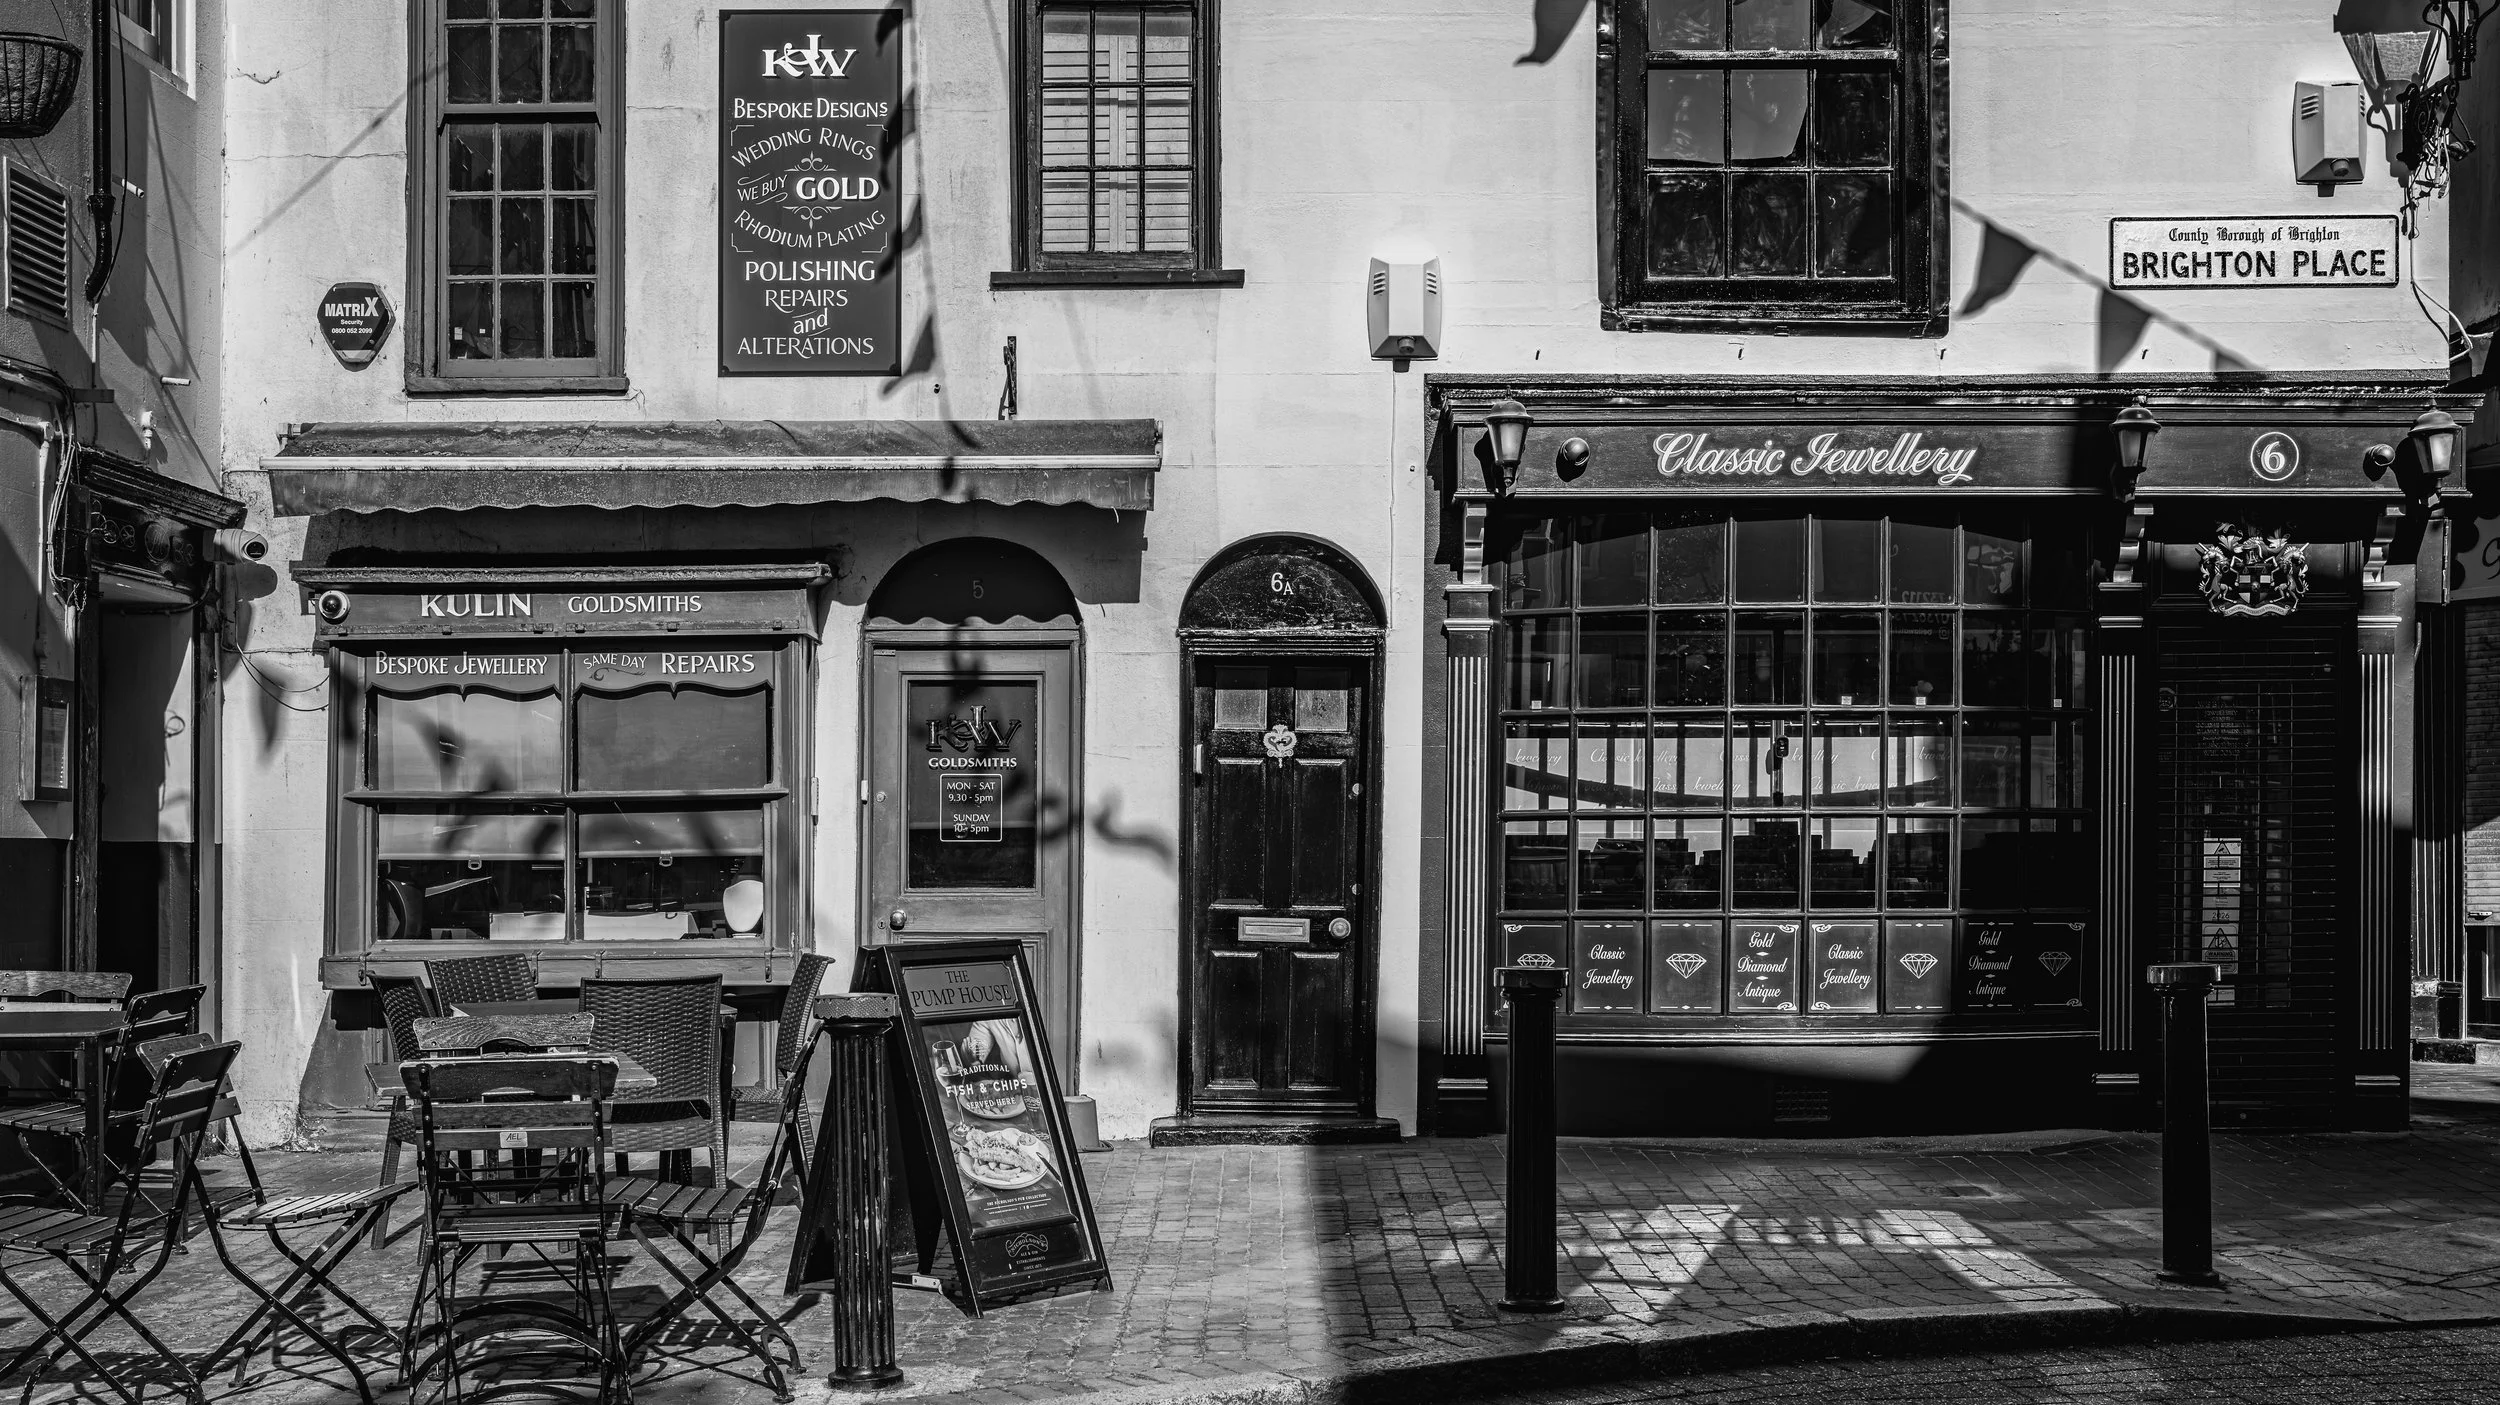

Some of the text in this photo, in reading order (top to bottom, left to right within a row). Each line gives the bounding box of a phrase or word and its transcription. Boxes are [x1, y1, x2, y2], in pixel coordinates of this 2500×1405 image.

[734, 98, 813, 119] BESPOKE
[732, 127, 877, 168] WEDDING RINGS
[737, 174, 880, 202] WE BUY GOLD
[733, 209, 886, 248] RHODIUM PLATING
[2168, 226, 2340, 245] County Borough of Brighton
[745, 260, 876, 282] POLISHING
[2122, 249, 2386, 279] BRIGHTON PLACE
[324, 297, 379, 317] MATRIX
[765, 288, 848, 312] REPAIRS
[340, 318, 364, 326] Security
[793, 308, 828, 335] and
[737, 337, 874, 359] ALTERATIONS
[1653, 432, 1979, 486] Classic Jewellery
[2260, 440, 2285, 473] 6
[972, 580, 984, 599] 5
[1271, 572, 1294, 596] 6A
[420, 593, 702, 618] KULIN GOLDSMITHS
[375, 651, 755, 676] BESPOKE JEWELLERY SAME DAY REPAIRS
[928, 757, 1017, 769] GOLDSMITHS
[947, 782, 971, 790] MON
[979, 782, 996, 790] SAT
[948, 793, 968, 802] 9.30
[974, 793, 994, 804] 5pm
[953, 813, 991, 822] SUNDAY
[970, 823, 990, 835] 5pm
[1749, 931, 1775, 948] Gold
[1978, 930, 2002, 946] Gold
[1589, 944, 1627, 960] Classic
[1828, 944, 1864, 960] Classic
[1737, 956, 1787, 973] Diamond
[1968, 955, 2013, 971] Diamond
[945, 970, 970, 984] THE
[1582, 968, 1634, 989] Jewellery
[1820, 968, 1871, 989] Jewellery
[911, 984, 1012, 1008] PUMP HOUSE
[1737, 982, 1781, 1003] Antique
[1968, 980, 2007, 1000] Antique
[957, 1063, 1010, 1077] TRADITIONAL
[945, 1078, 1028, 1098] FISH & CHIPS
[966, 1100, 995, 1110] SERVED
[995, 1096, 1017, 1107] HERE
